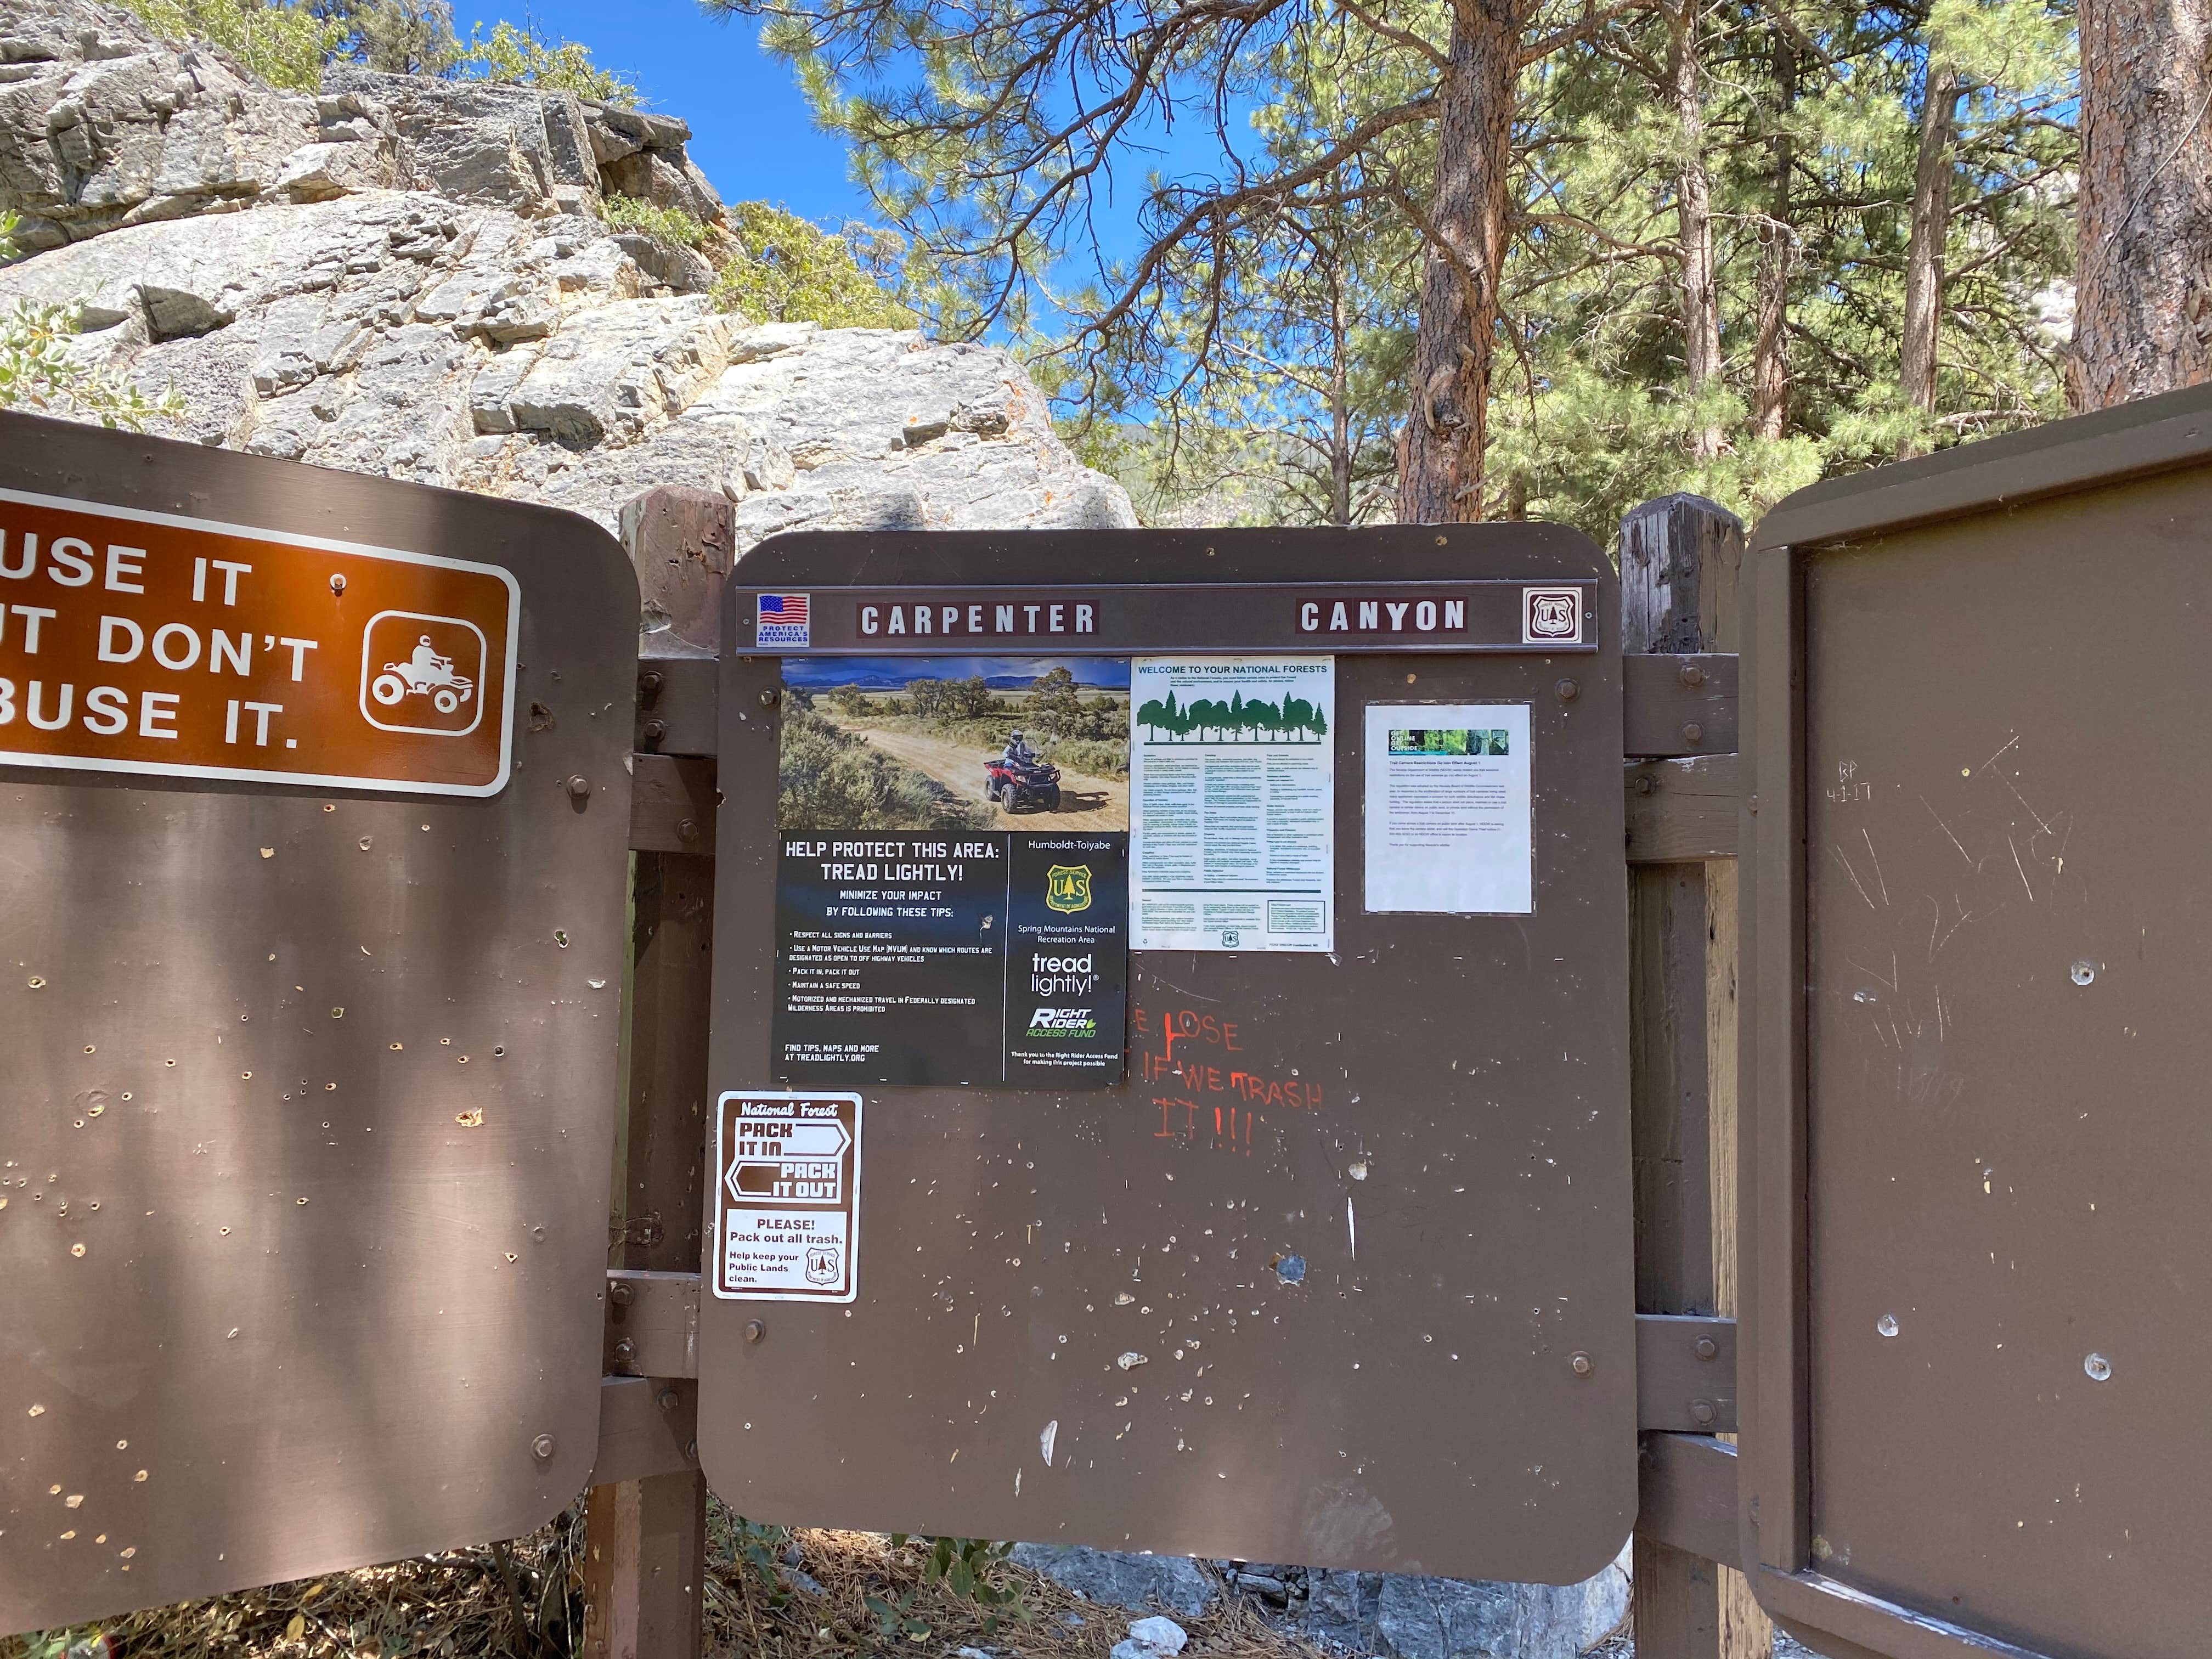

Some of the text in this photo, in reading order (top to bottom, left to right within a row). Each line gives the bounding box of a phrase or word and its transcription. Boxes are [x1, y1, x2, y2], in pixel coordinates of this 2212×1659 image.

[0, 529, 252, 606] USE IT
[861, 600, 1464, 635] CARPENTER CANYON
[0, 603, 318, 682] T DON'T
[225, 699, 297, 748] IT.
[786, 842, 999, 858] HELP PROTECT THIS AREA:
[1028, 840, 1110, 851] Humboldt-Toiyabe
[821, 864, 963, 881] TREAD LIGHTLY!
[839, 890, 942, 900] MINIMIZE YOUR IMPACT
[826, 906, 953, 917] BY FOLLOWING THESE TIPS:
[1018, 925, 1042, 934] Spring
[887, 944, 908, 953] (MVUM)
[1032, 953, 1092, 973] tread
[1026, 1029, 1096, 1038] ACCESS FUND
[1164, 1011, 1243, 1062] LOSE
[803, 1044, 821, 1053] TIPS,
[797, 1053, 865, 1062] TREADLIGHTLY.ORG
[1144, 1051, 1322, 1111] IF WE TRASH
[741, 1102, 839, 1117] National Forest
[1152, 1097, 1199, 1140] IT
[740, 1123, 793, 1137] PACK
[740, 1141, 758, 1156] IT
[781, 1163, 836, 1179] PACK
[773, 1181, 836, 1198] IT OUT
[757, 1218, 815, 1230] PLEASE!
[730, 1232, 842, 1244] Pack out all trash.
[730, 1251, 750, 1261] Help
[753, 1252, 776, 1261] keep
